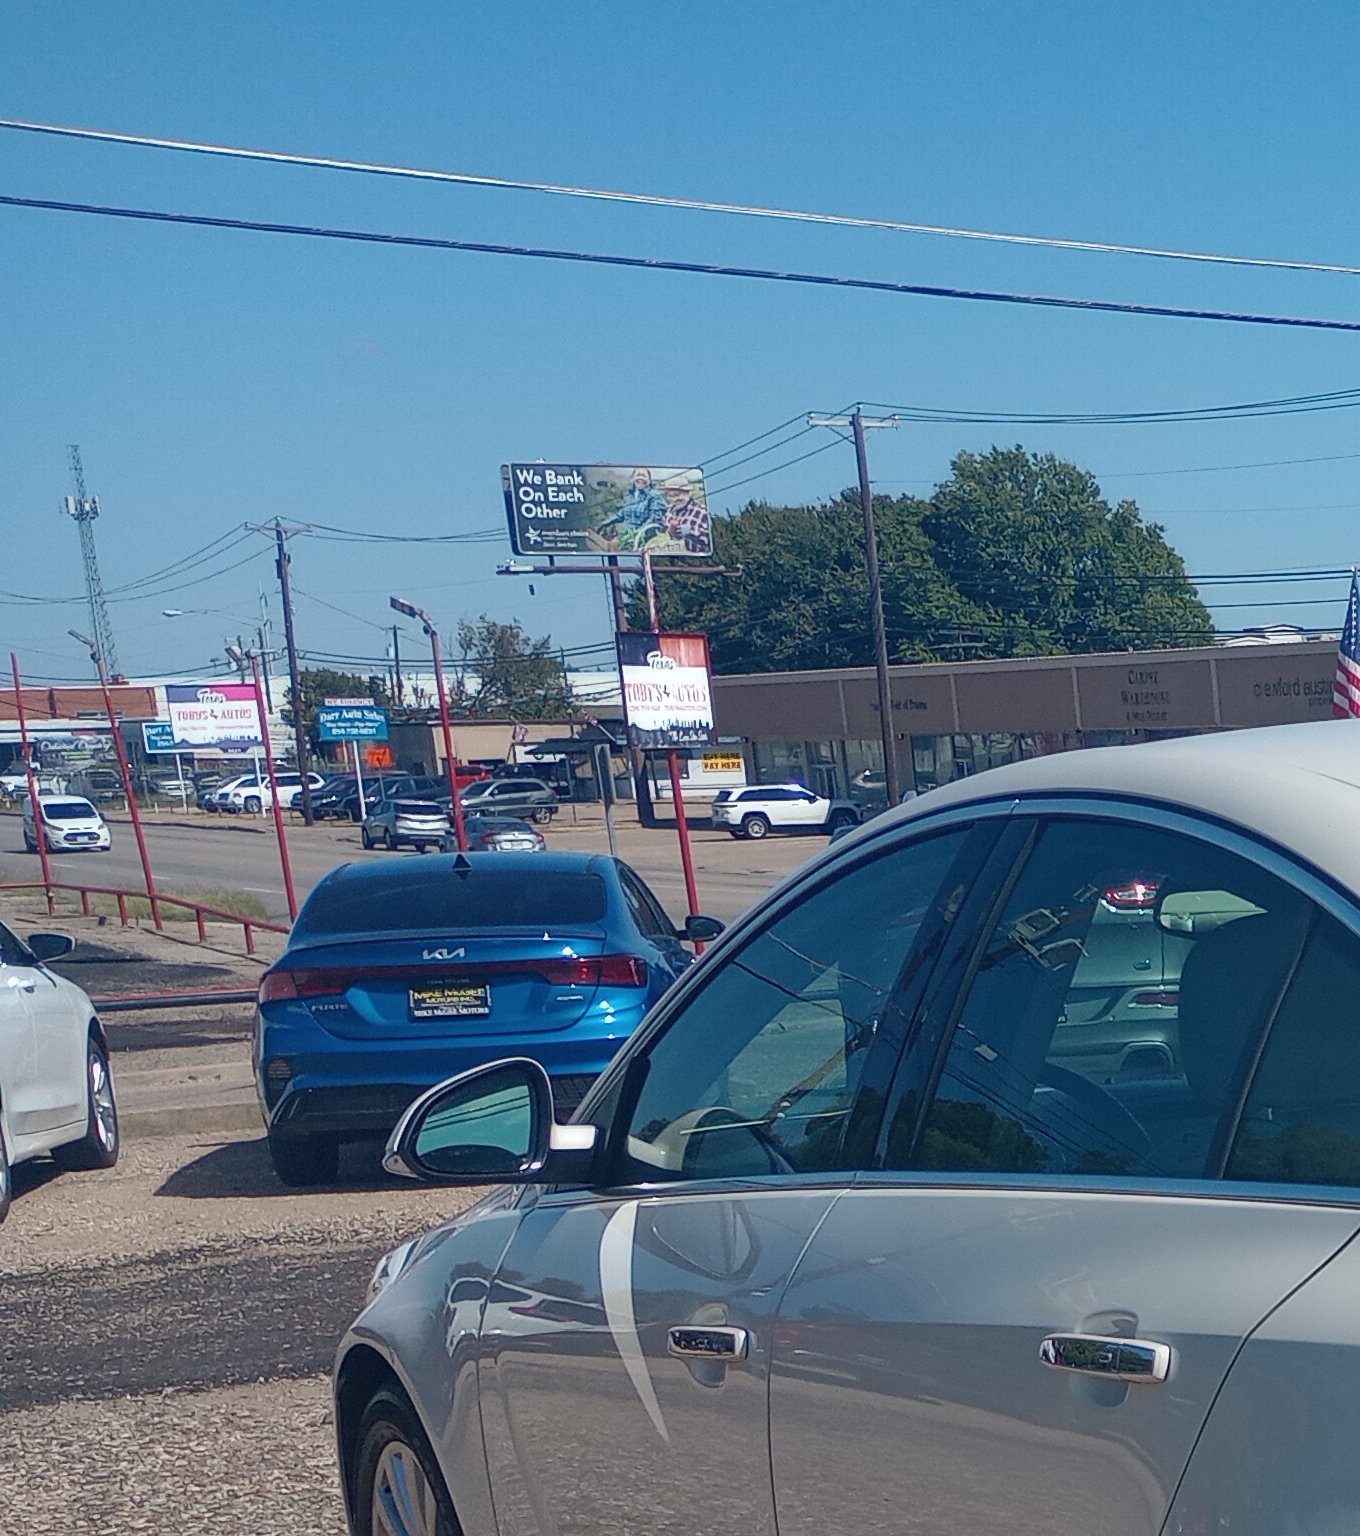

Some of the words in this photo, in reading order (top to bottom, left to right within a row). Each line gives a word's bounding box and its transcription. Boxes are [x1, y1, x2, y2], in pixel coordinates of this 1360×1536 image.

[516, 468, 542, 485] We
[545, 469, 584, 486] Bank
[519, 486, 544, 501] On
[547, 486, 584, 502] Each
[521, 503, 568, 519] Other
[221, 708, 252, 720] AUTOS
